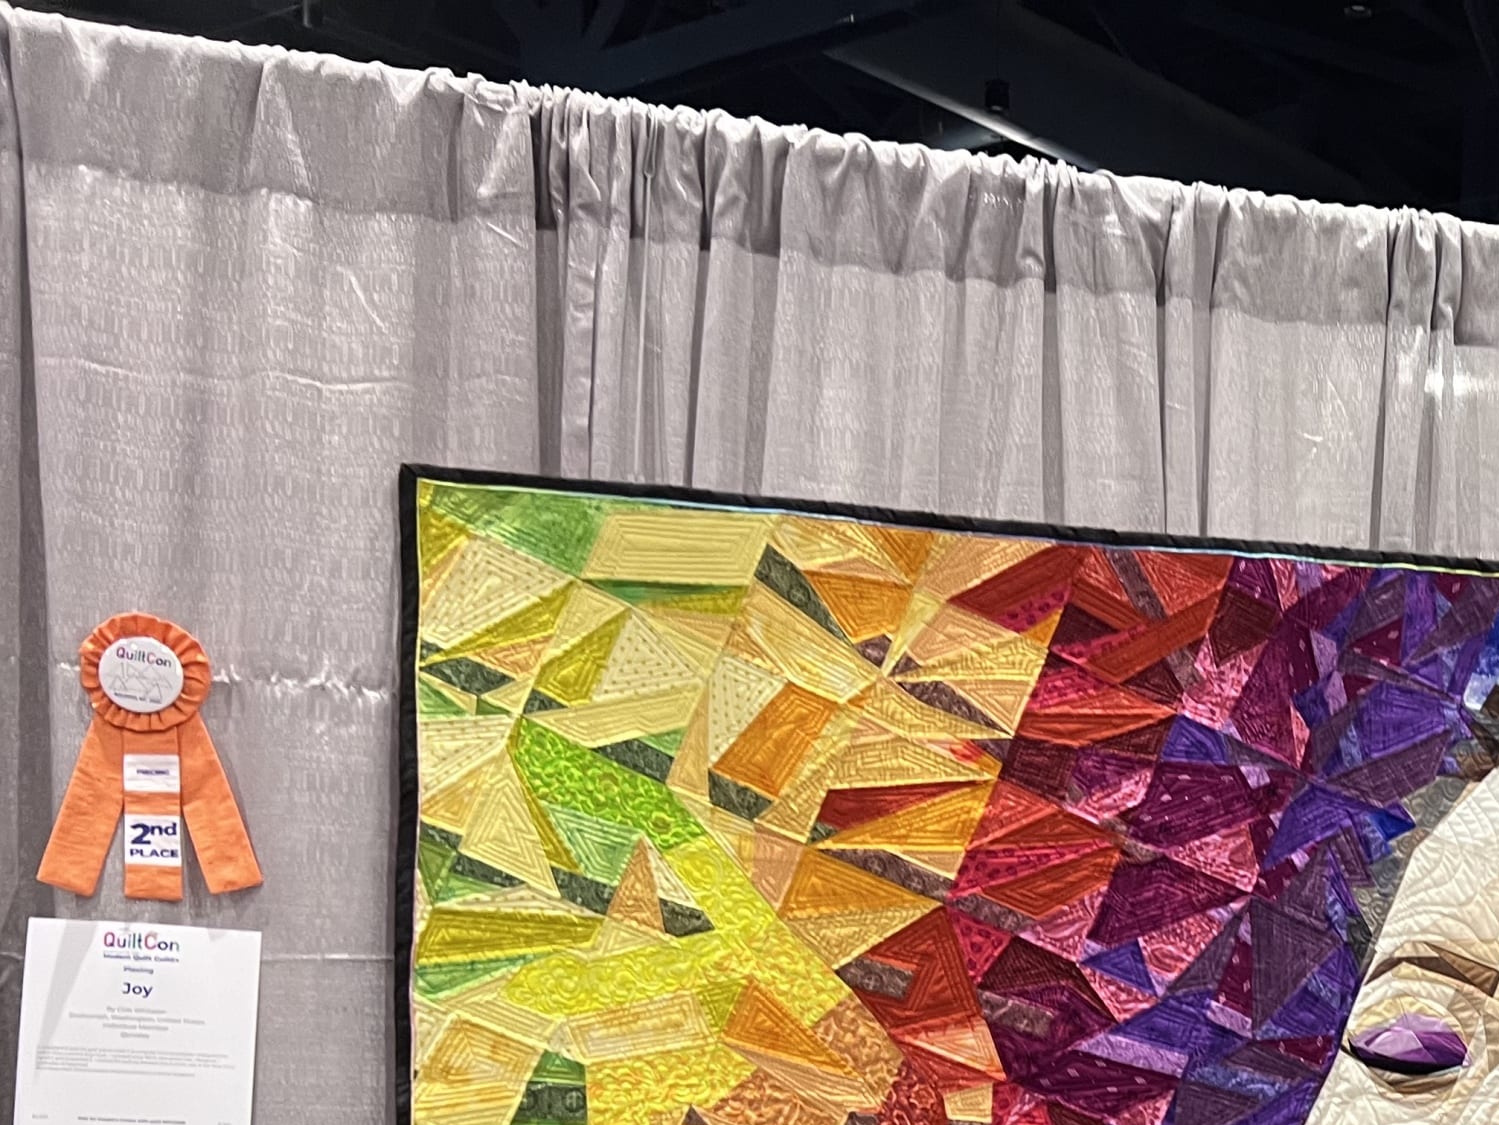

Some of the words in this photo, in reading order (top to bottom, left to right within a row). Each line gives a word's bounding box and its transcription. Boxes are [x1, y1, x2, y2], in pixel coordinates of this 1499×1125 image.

[116, 646, 172, 668] QuiltCon
[130, 821, 177, 845] 2nd
[130, 848, 179, 858] PLACE
[103, 930, 180, 952] QuiltCon
[122, 981, 153, 999] Joy
